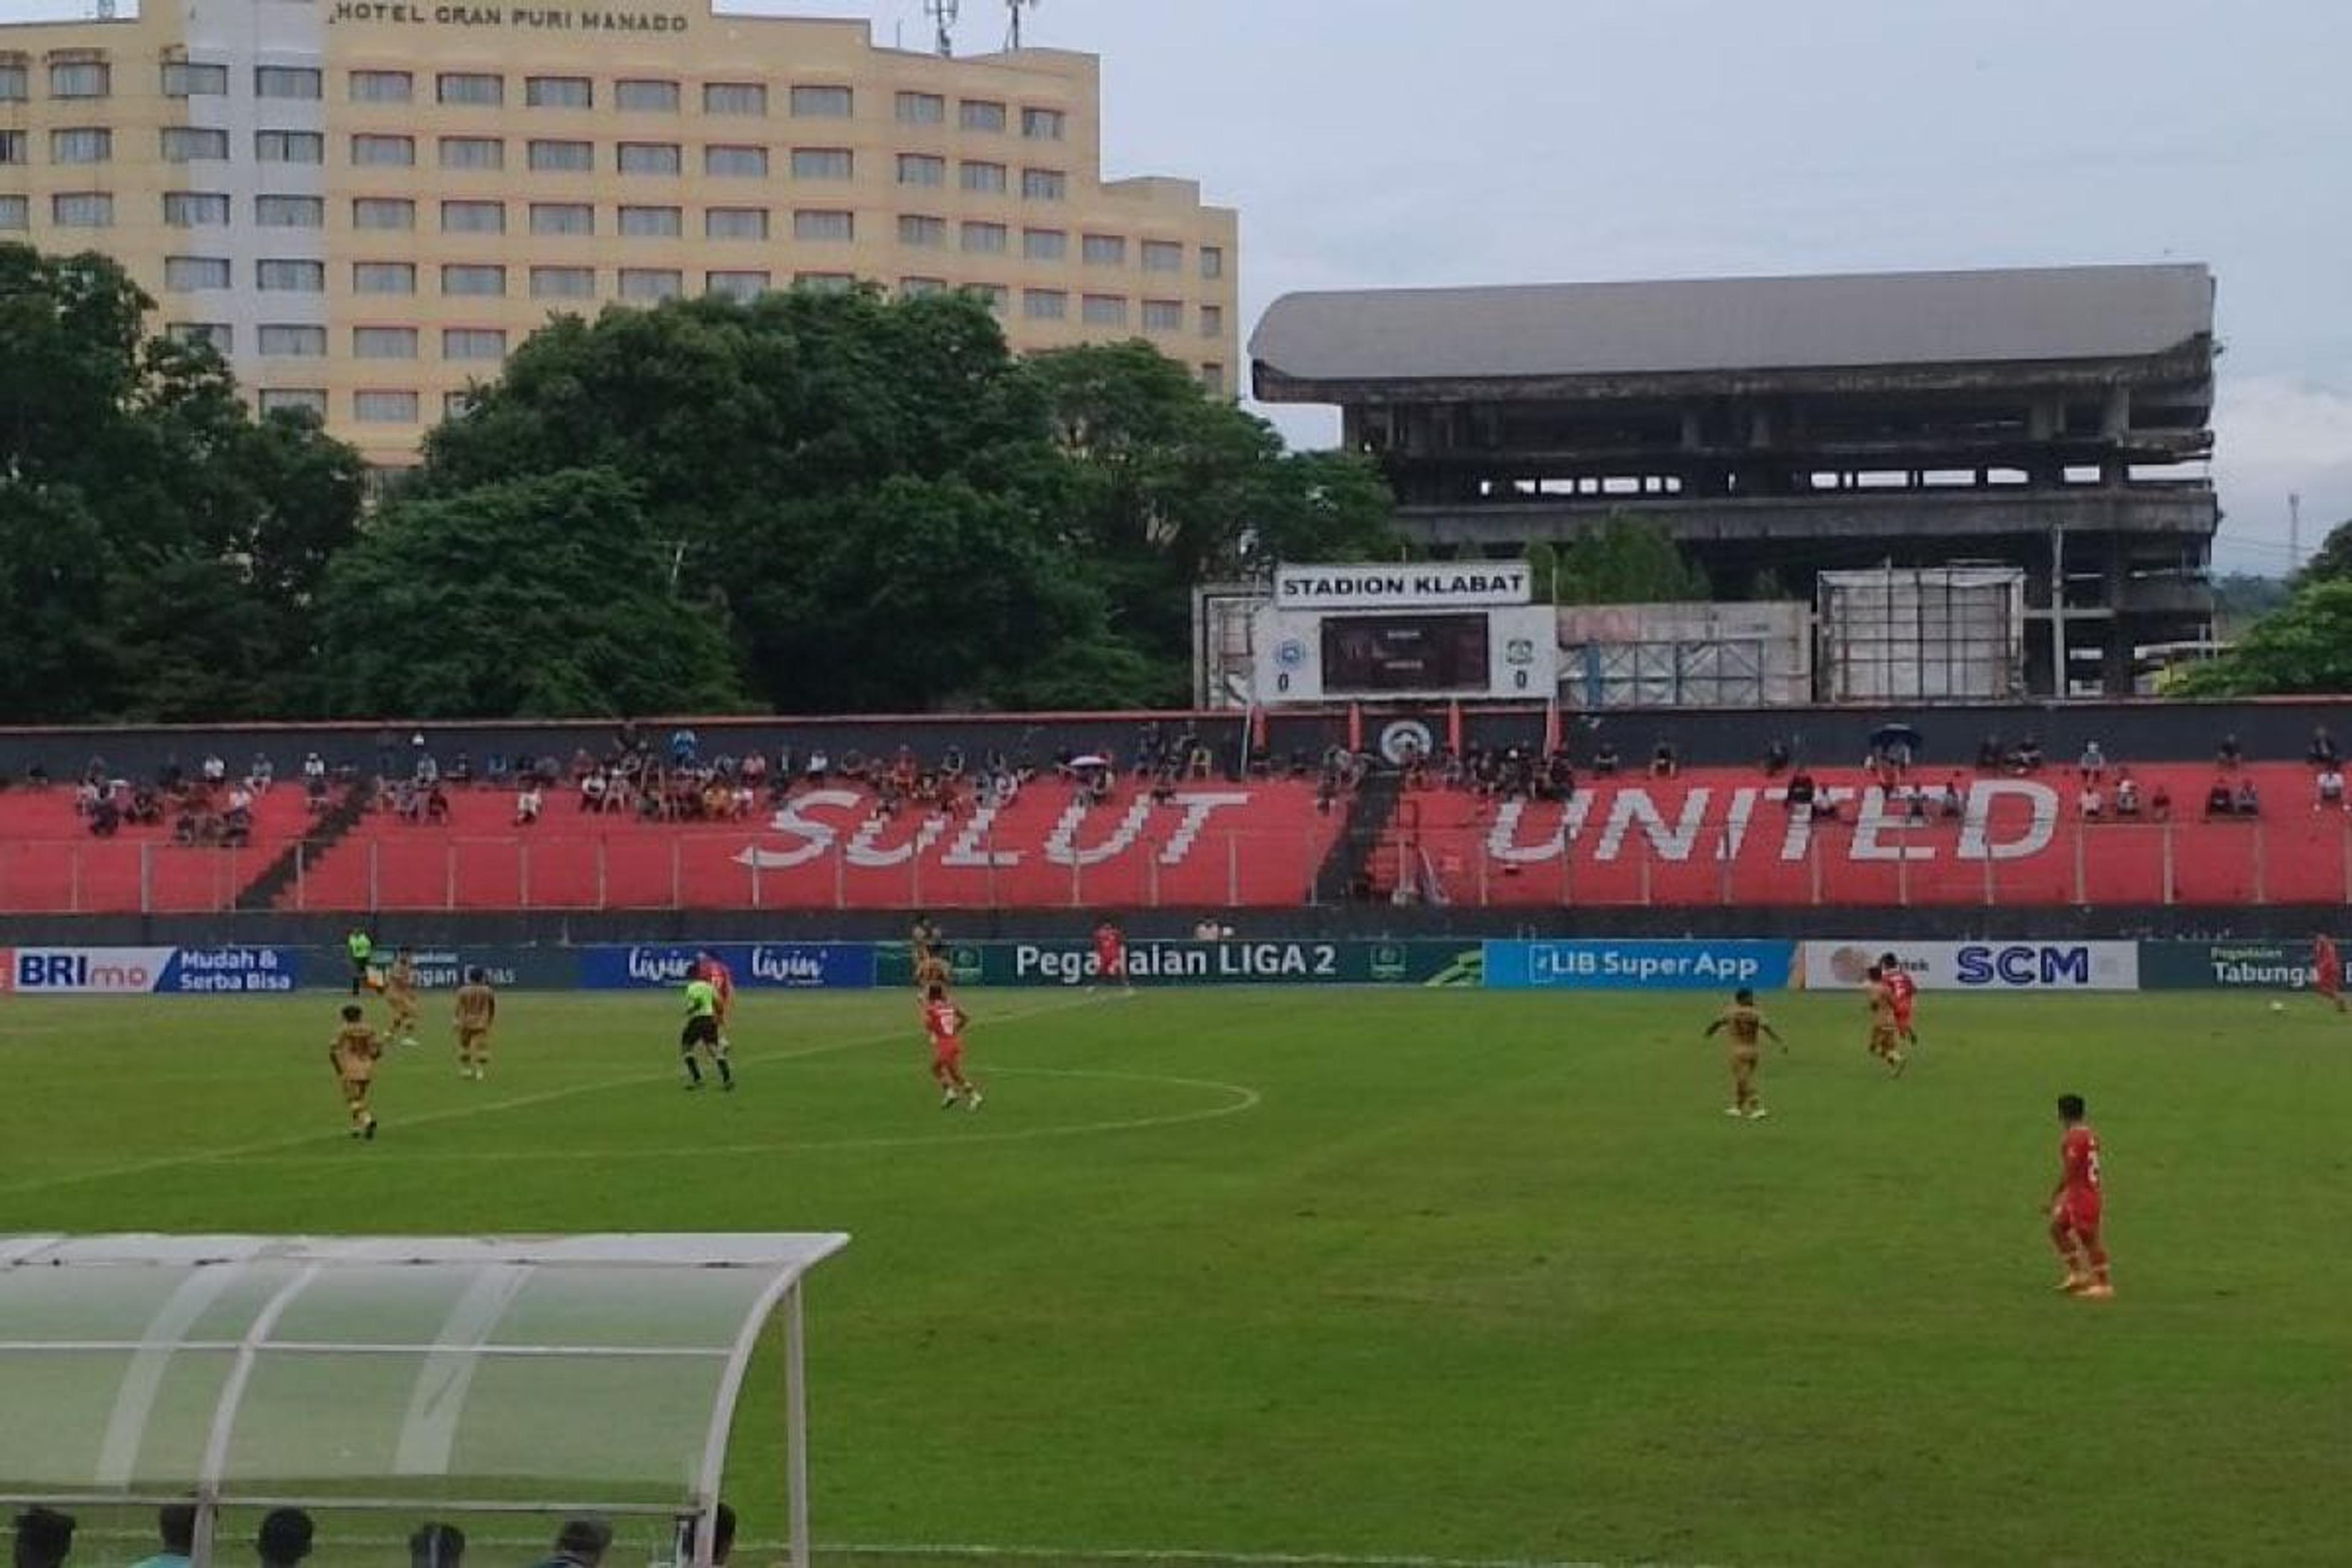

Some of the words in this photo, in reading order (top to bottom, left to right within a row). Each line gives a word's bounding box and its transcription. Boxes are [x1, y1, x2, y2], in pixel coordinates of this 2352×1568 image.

[337, 2, 424, 23] HOTEL
[435, 5, 500, 24] GRAN
[512, 9, 571, 29] PURI
[582, 11, 688, 31] MANADO
[1284, 578, 1404, 595] STADION
[1413, 574, 1524, 594] KLABAT
[736, 790, 1248, 865] SULUT
[1487, 779, 2059, 863] UNITED
[183, 950, 254, 969] Mudah
[1220, 944, 1306, 974] LIGA
[1314, 944, 1336, 974] 2
[1552, 951, 1594, 974] LIB
[1605, 952, 1689, 980] Super
[1693, 952, 1758, 979] App
[1957, 946, 2089, 984] SCM
[183, 972, 241, 990] Serba
[247, 972, 290, 990] Bisa
